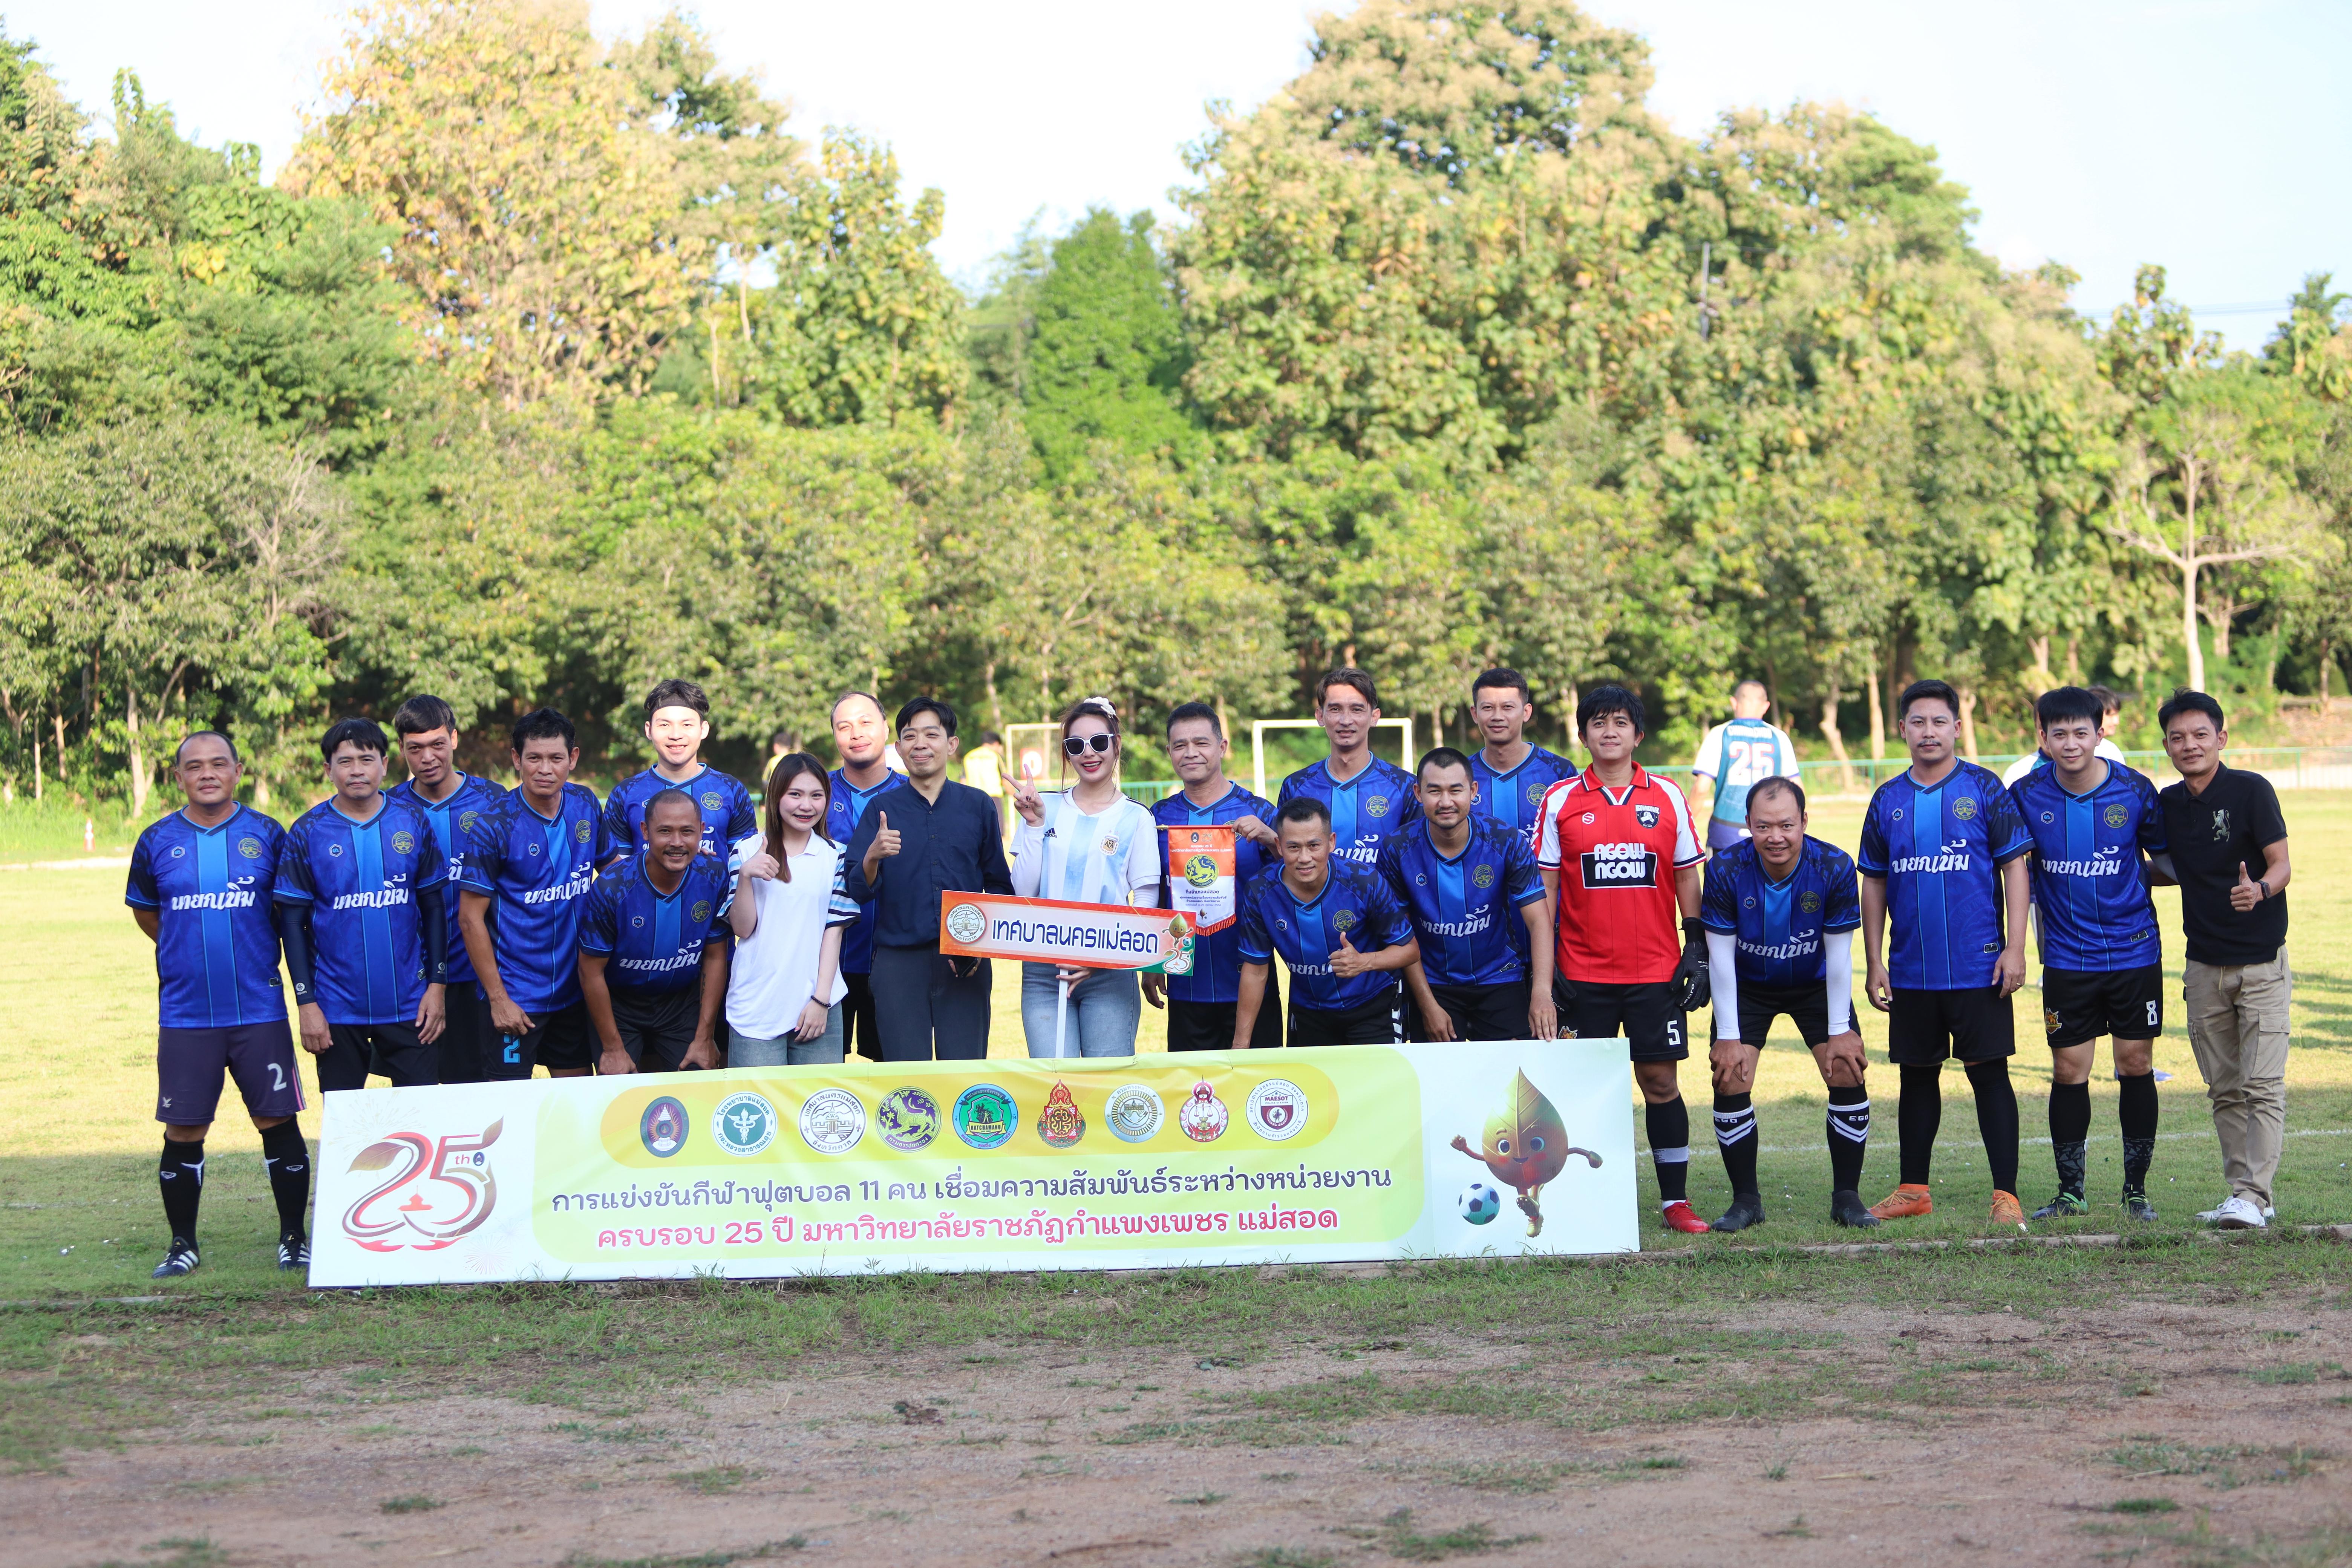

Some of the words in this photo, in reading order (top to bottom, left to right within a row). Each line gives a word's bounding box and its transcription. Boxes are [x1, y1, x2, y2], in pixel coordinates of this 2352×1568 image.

[1727, 741, 1775, 786] 25
[1595, 861, 1646, 879] NGOW
[992, 920, 1158, 954] เทศบาลนครแม่สอด
[2146, 1000, 2158, 1026] 8
[1667, 1020, 1681, 1045] 5
[267, 1063, 287, 1091] 2
[342, 1124, 502, 1238] 25
[455, 1154, 470, 1165] th
[552, 1179, 850, 1212] การแข่งขันกีฬาฟุตบอล
[859, 1180, 879, 1200] 11
[888, 1182, 926, 1200] คน
[935, 1163, 1392, 1199] เชื่อมความสัมพันธ์ระหว่างหน่วยงาน
[599, 1226, 715, 1248] ครบรอบ
[725, 1221, 763, 1244] 25
[772, 1215, 793, 1242] ปี
[803, 1209, 1229, 1243] มหาวิทยาลัยราชภัฏกำแพงเพชร
[1239, 1202, 1338, 1230] แม่สอด
